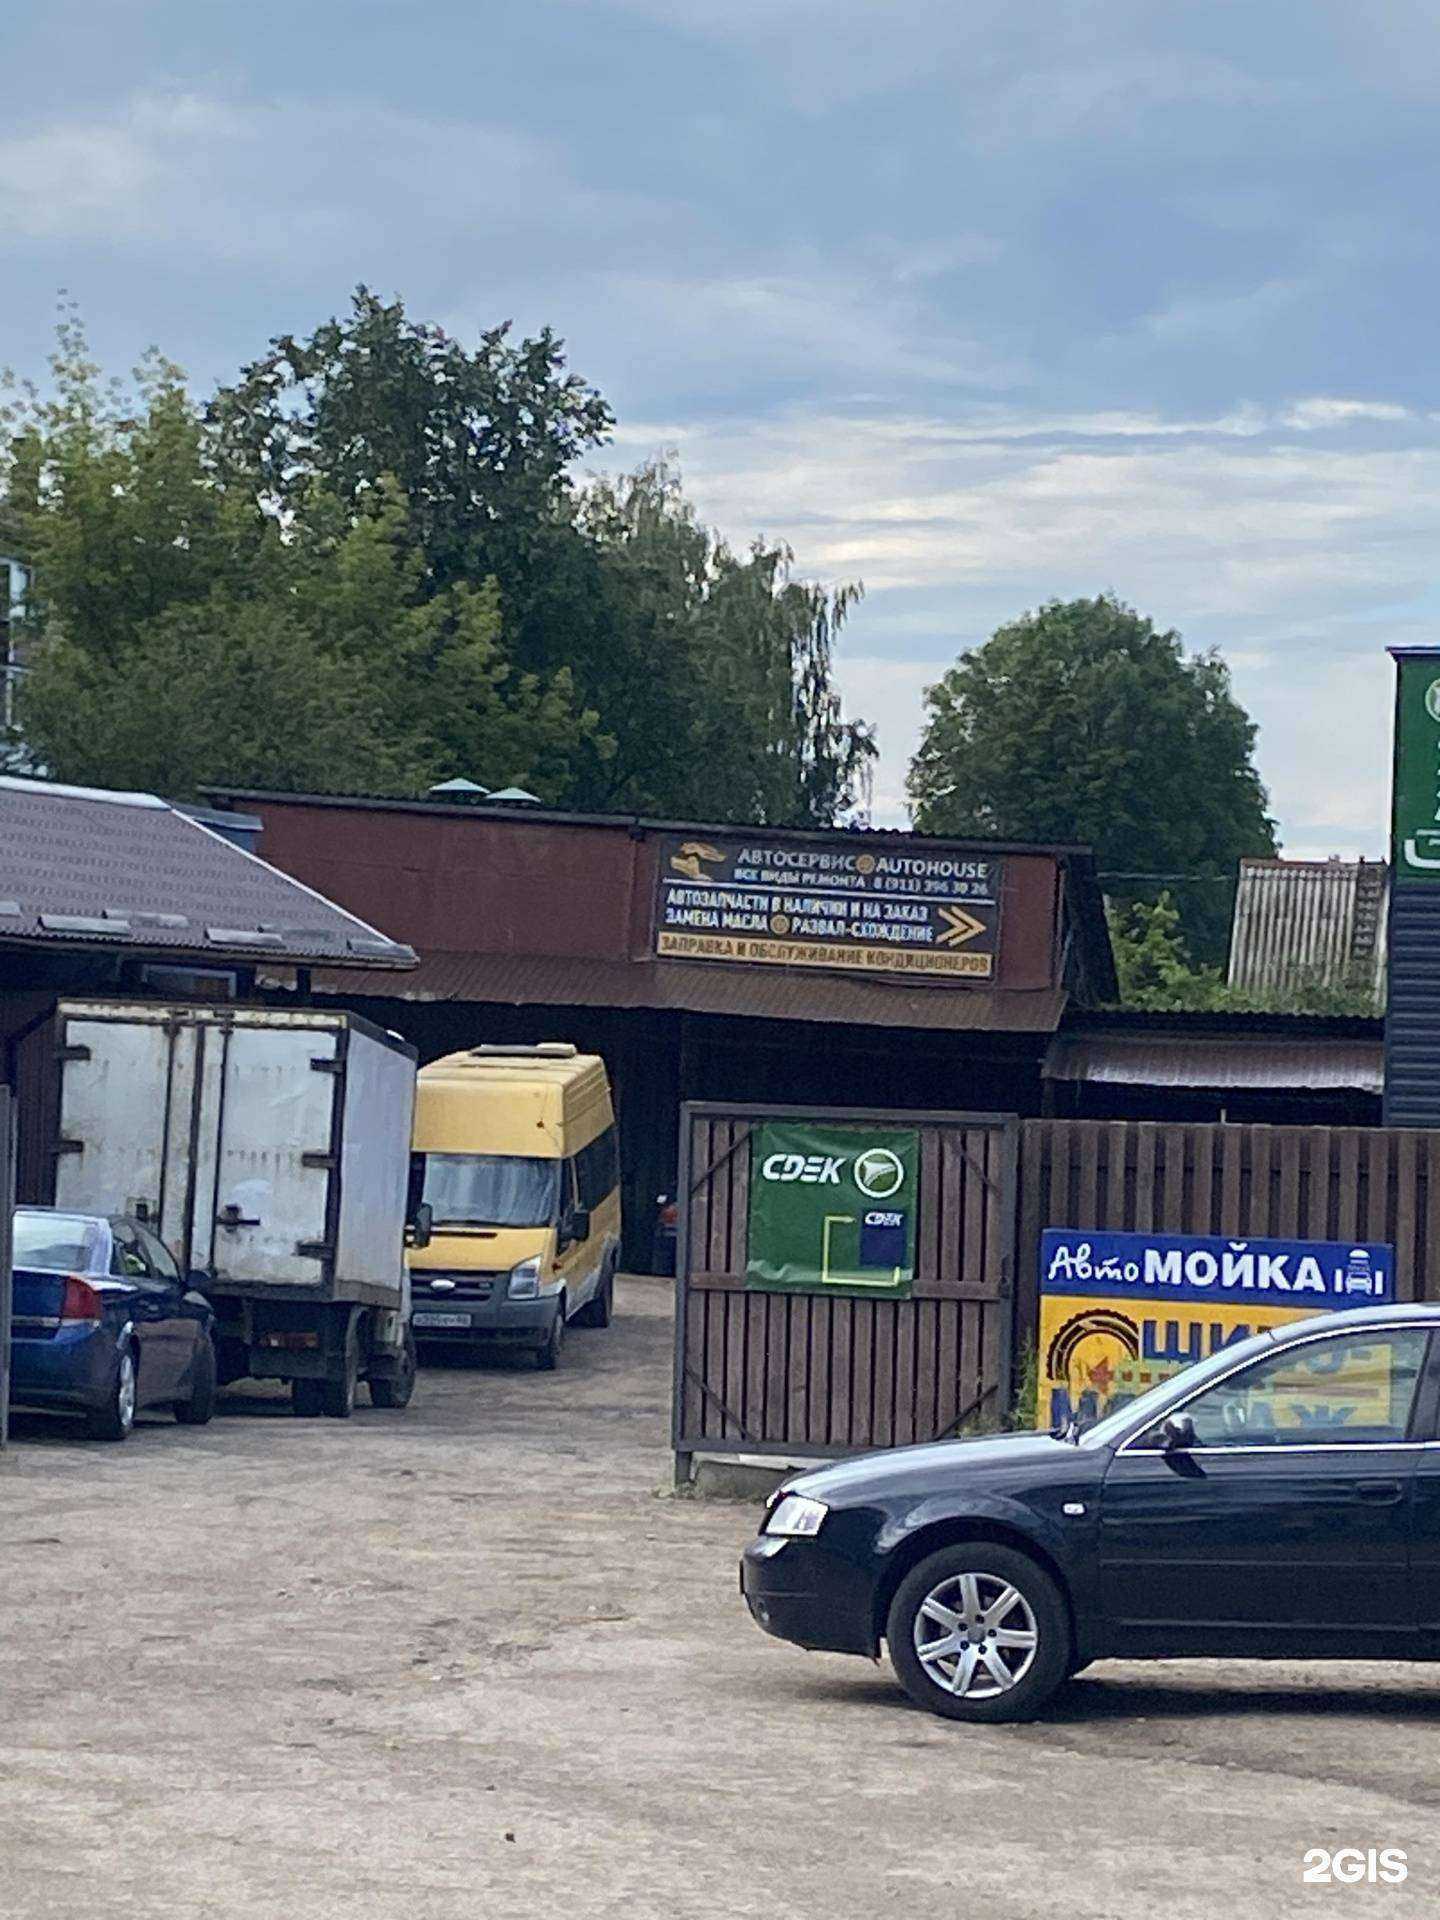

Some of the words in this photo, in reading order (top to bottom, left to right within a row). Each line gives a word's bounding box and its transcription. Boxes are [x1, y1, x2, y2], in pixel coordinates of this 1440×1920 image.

[733, 868, 758, 881] ВСЕ
[760, 869, 800, 885] ВИДЫ
[802, 872, 866, 889] РЕМОНТА
[737, 848, 856, 870] АВТОСЕРВИС
[876, 857, 988, 878] AUTOHOUSE
[666, 887, 770, 912] АВТОЗАПЧАСТИ
[851, 901, 861, 917] И
[863, 902, 882, 919] НА
[884, 904, 930, 922] ЗАКАЗ
[665, 907, 719, 929] ЗАМЕНА
[721, 911, 769, 932] МАСЛА
[791, 917, 935, 943] РАЗВАЛ-СХОЖДЕНИЕ
[661, 935, 735, 957] ЗАПРАВКА
[737, 942, 747, 957] И
[749, 941, 863, 967] ОБСЛУЖИВАНИЕ
[763, 1153, 847, 1184] CDEK
